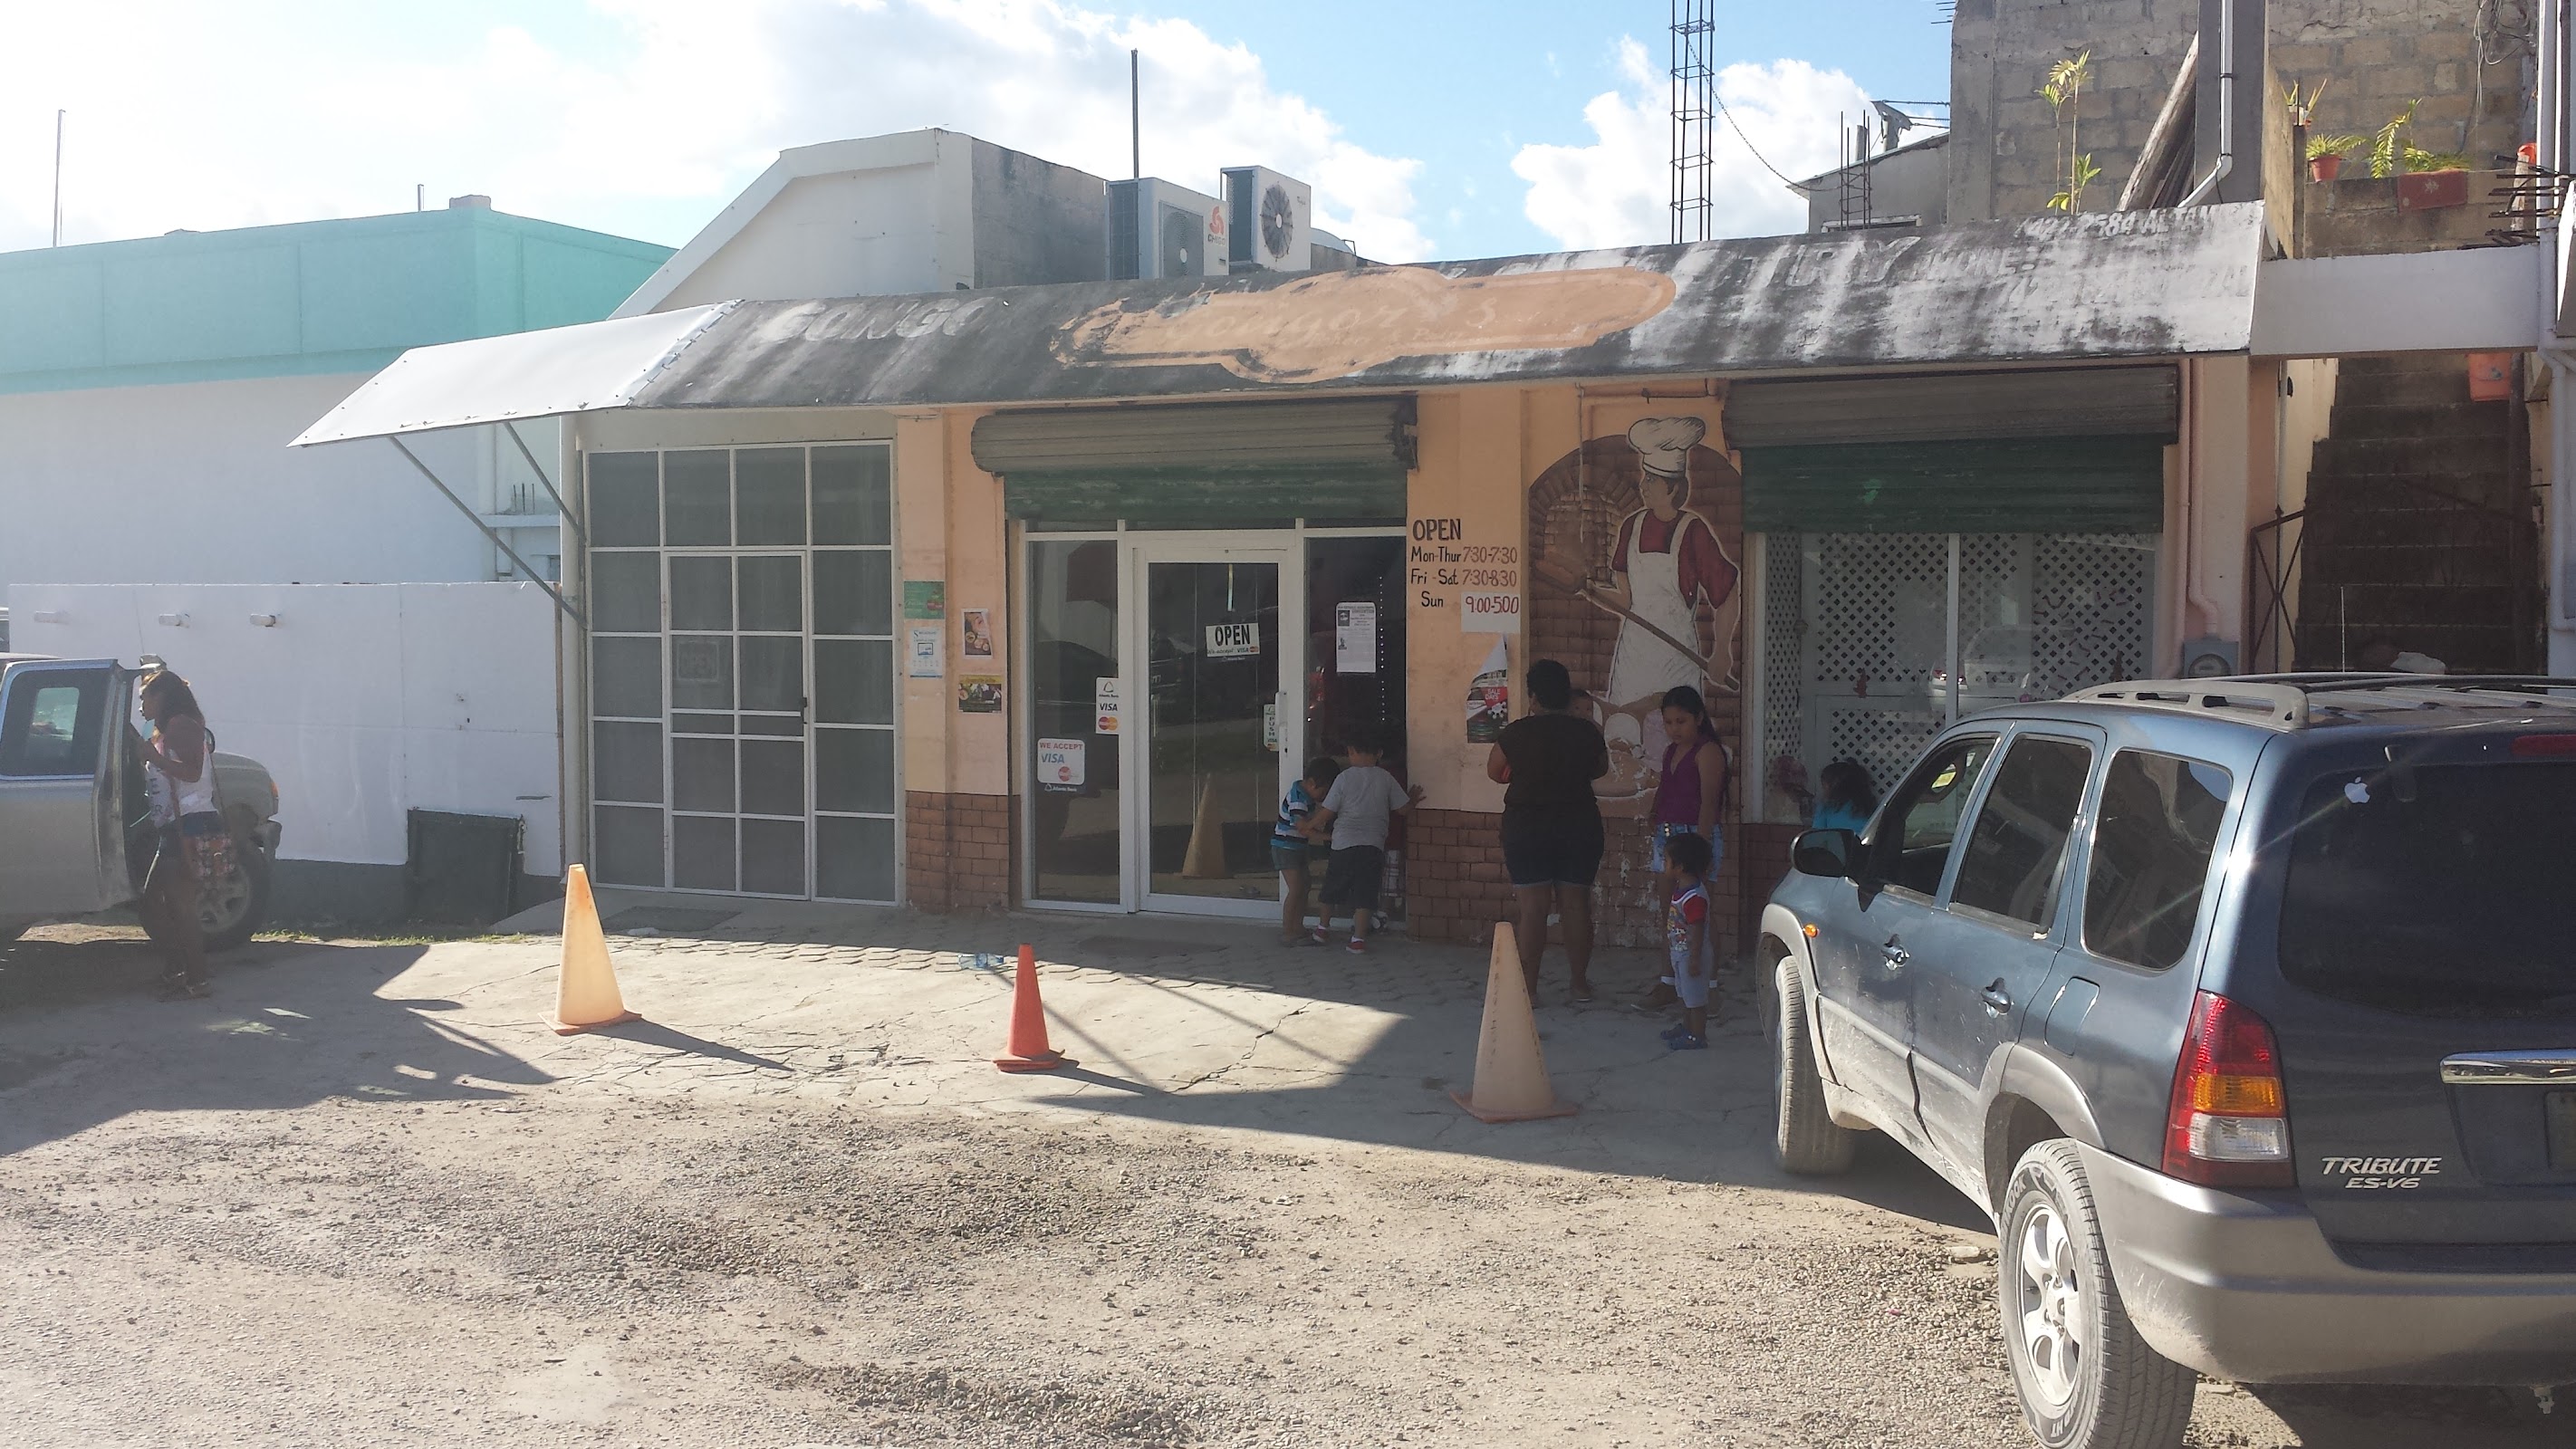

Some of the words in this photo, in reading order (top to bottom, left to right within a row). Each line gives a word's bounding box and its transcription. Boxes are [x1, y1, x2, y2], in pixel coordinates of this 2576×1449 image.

[1413, 518, 1461, 541] OPEN
[1410, 568, 1427, 585] Fri
[1421, 590, 1444, 608] Sun
[1215, 624, 1251, 647] OPEN
[1100, 703, 1119, 711] VISA
[1041, 753, 1065, 763] VISA
[2321, 1156, 2443, 1176] TRIBUTE
[2344, 1176, 2421, 1189] ES-V6
